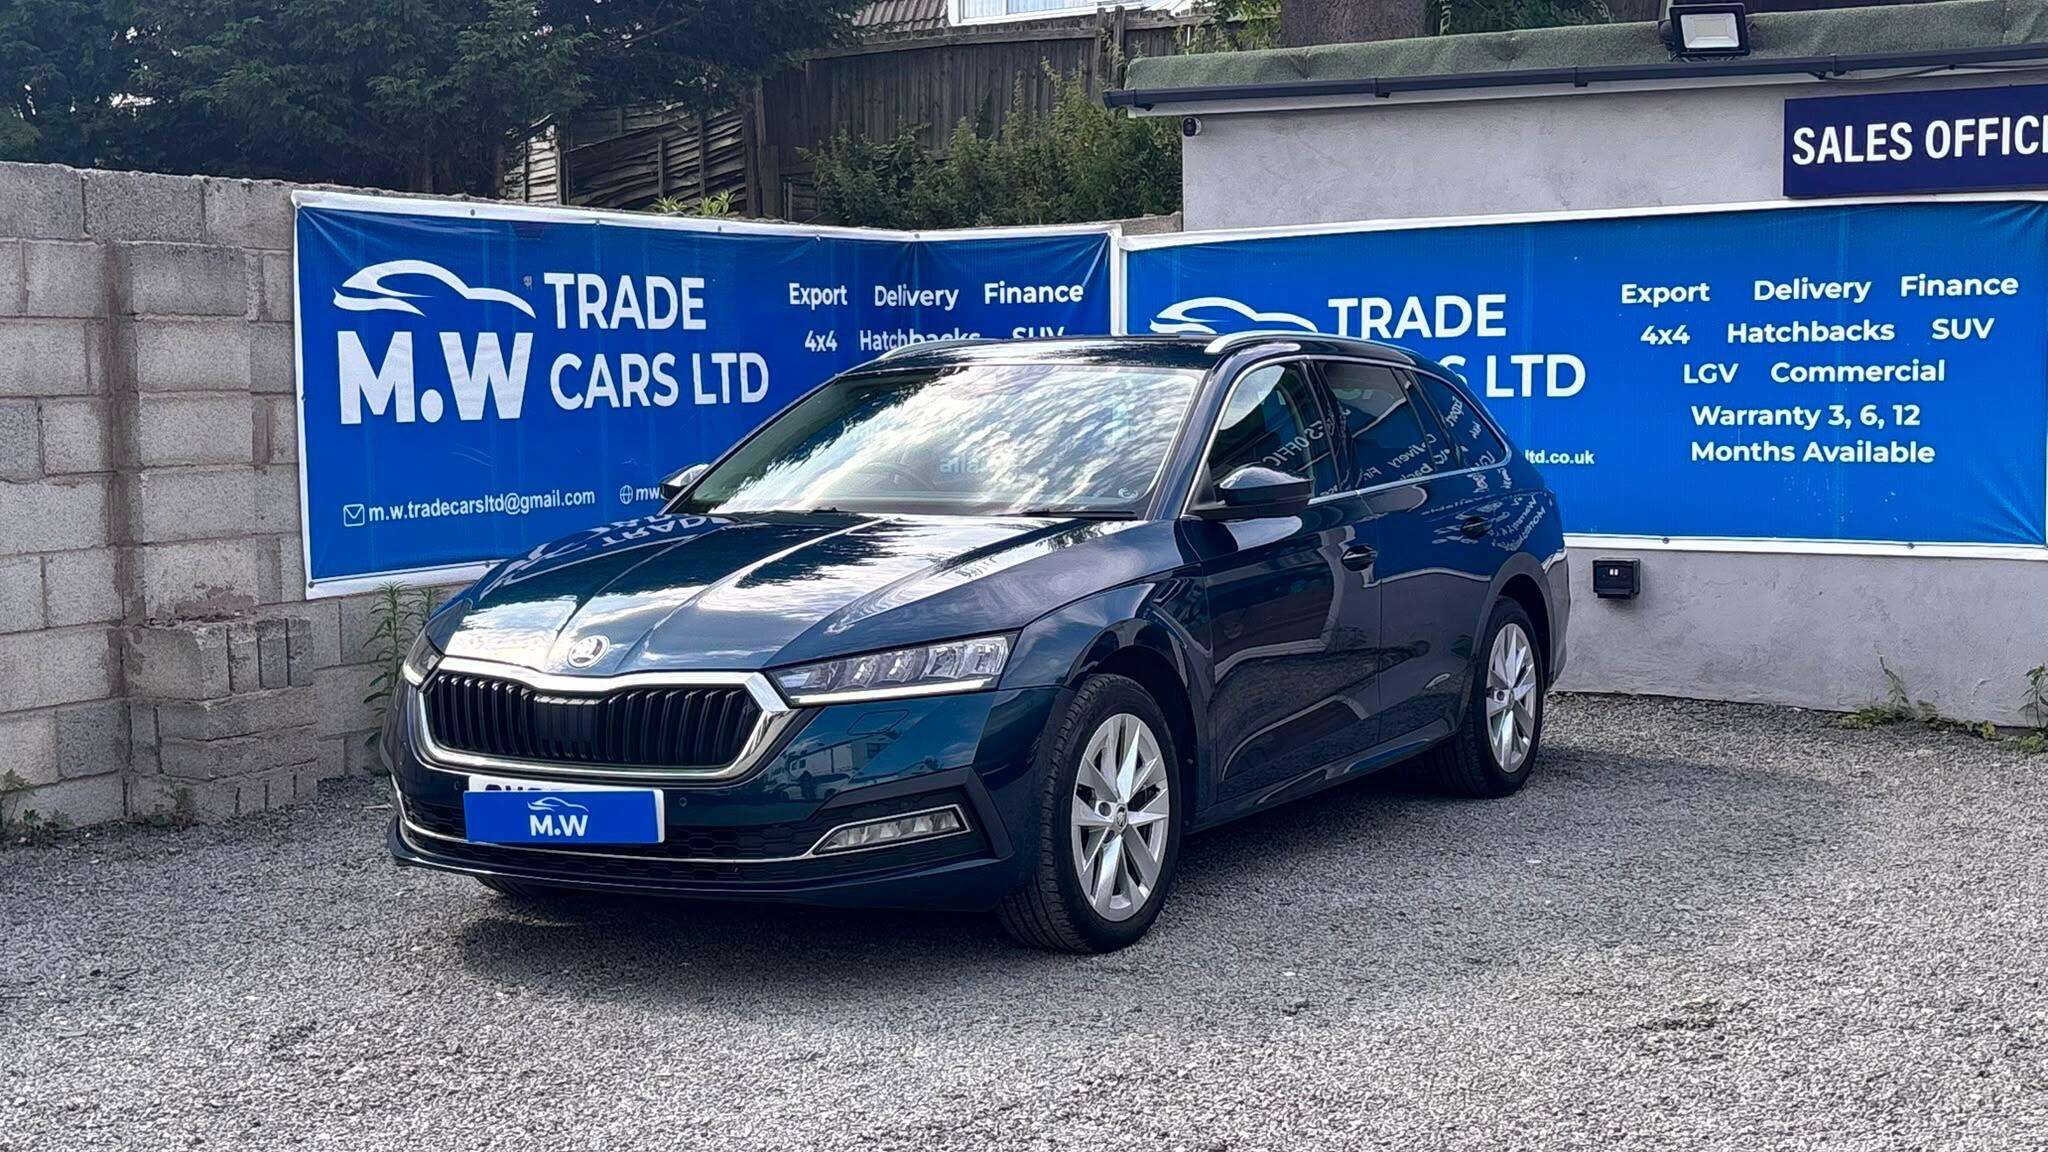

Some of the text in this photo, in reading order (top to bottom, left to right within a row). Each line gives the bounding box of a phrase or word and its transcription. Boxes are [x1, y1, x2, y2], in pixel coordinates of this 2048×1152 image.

[1792, 114, 2048, 166] SALES OFFIC
[543, 272, 707, 330] TRADE
[788, 280, 1084, 311] Export Delivery Finance
[1621, 273, 2019, 308] Export Delivery Finance
[1328, 293, 1507, 340] TRADE
[1640, 317, 1995, 345] 4x4 Hatchbacks SUV
[804, 330, 838, 352] 4x4
[337, 330, 534, 425] M.W
[550, 352, 769, 410] CARS LTD
[1486, 353, 1586, 398] LTD
[1683, 358, 1945, 384] LGV Commercial
[1691, 404, 1921, 431] Warranty 3, 6, 12
[1524, 449, 1595, 465] ltd.co.uk
[1691, 439, 1936, 463] Months Available
[368, 489, 595, 522] m.w.tradecarsltd@gmail.com
[529, 814, 589, 837] M.W
